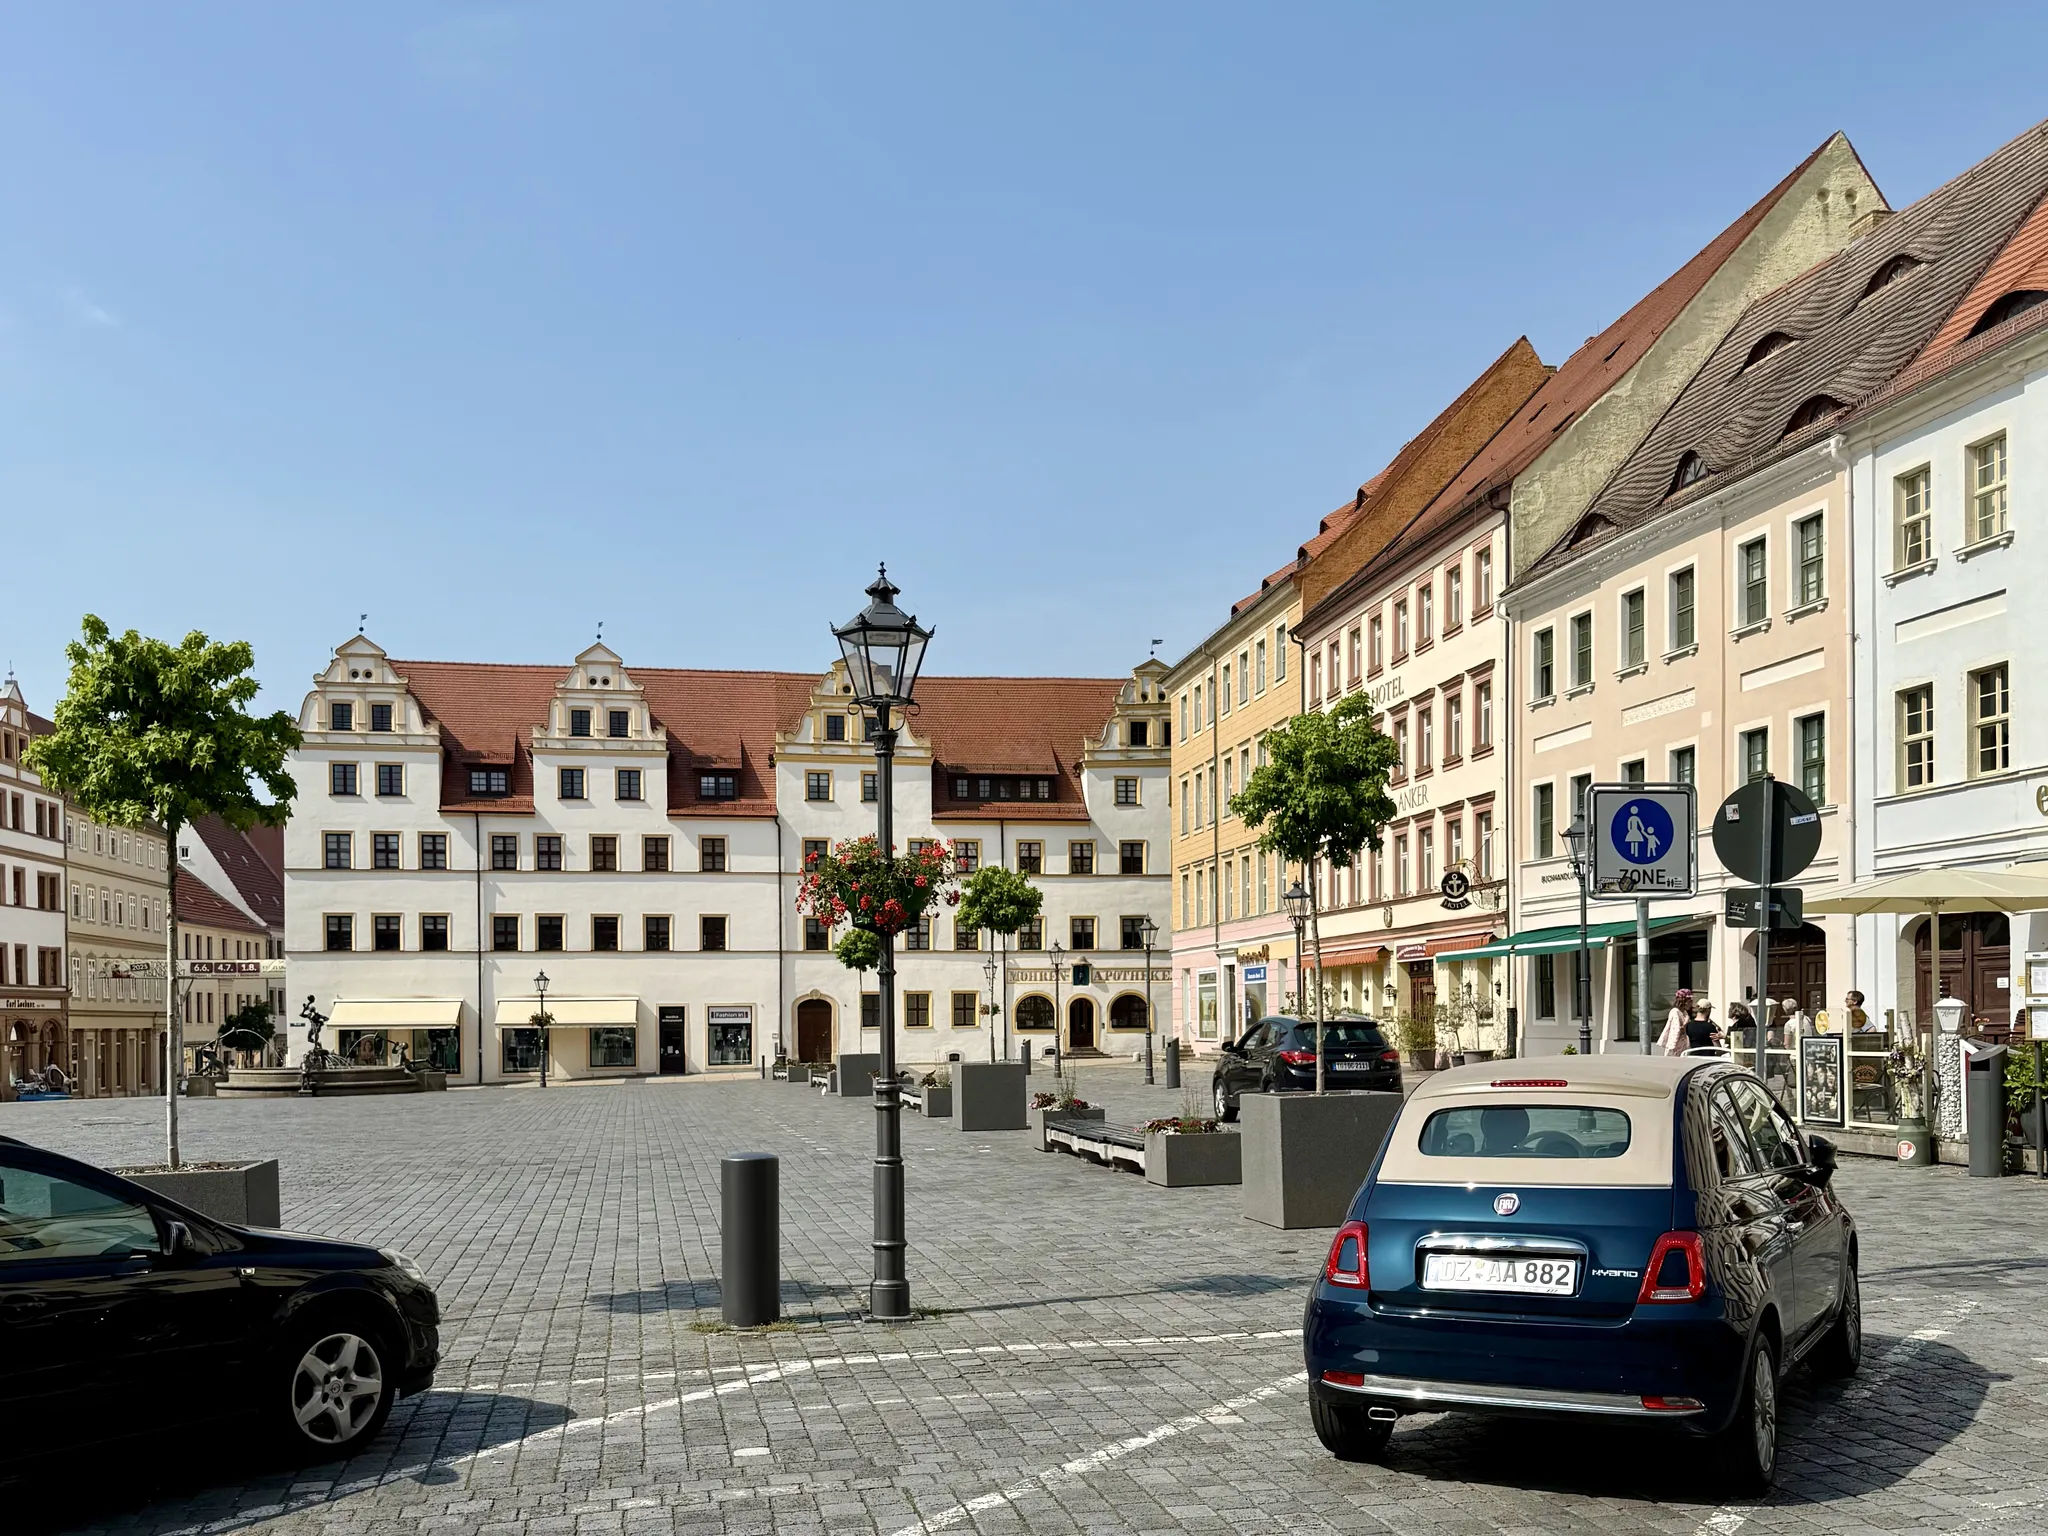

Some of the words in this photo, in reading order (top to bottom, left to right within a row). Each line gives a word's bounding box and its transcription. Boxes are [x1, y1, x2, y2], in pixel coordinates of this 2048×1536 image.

[1371, 676, 1404, 707] HOTEL
[1398, 784, 1429, 811] ANKER
[1619, 868, 1667, 885] ZONE
[1443, 900, 1468, 909] HOTEL
[217, 963, 234, 972] 4.7.
[241, 963, 257, 972] 1.8.
[1498, 1196, 1515, 1210] FIAT
[1523, 1262, 1570, 1286] 882
[1591, 1268, 1639, 1279] HYBRID
